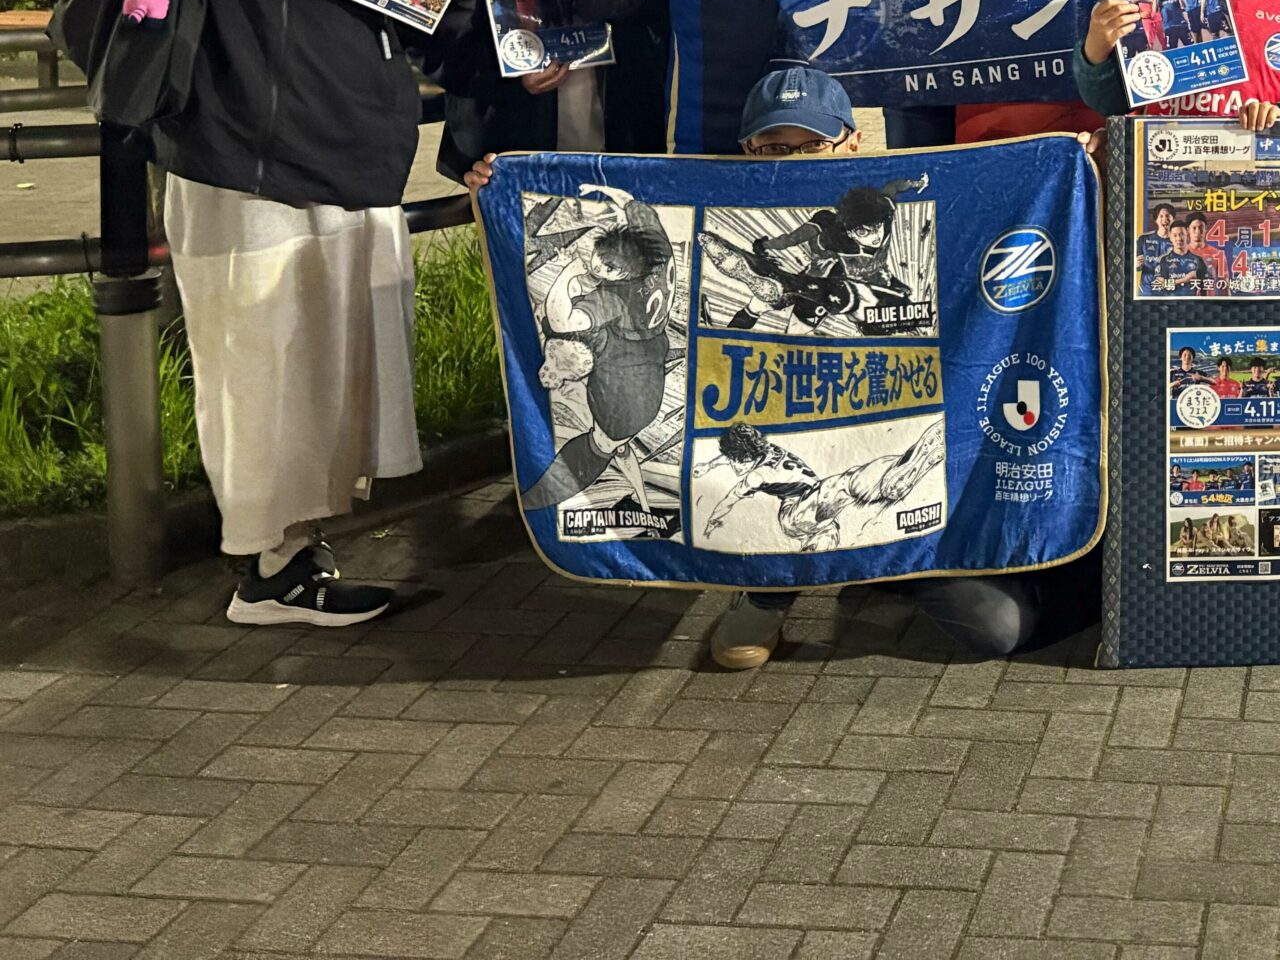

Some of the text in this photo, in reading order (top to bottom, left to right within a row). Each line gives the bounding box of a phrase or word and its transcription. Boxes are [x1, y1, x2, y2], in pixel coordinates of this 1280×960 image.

[560, 31, 586, 45] 4.11
[1190, 47, 1217, 65] 4.11
[905, 71, 938, 92] NA
[952, 63, 1021, 88] SANG
[1183, 135, 1218, 144] 明治安田
[866, 303, 930, 324] BLUE LOCK
[702, 344, 938, 422] Jが世界を驚かせる
[977, 352, 1069, 457] J.LEAGUE 100 YEAR VISION LEAGUE
[1244, 400, 1275, 417] 4.11
[995, 461, 1053, 479] 明治安田
[995, 490, 1053, 503] 百年構想リーグ
[566, 510, 668, 530] CAPTAIN TSUBASA
